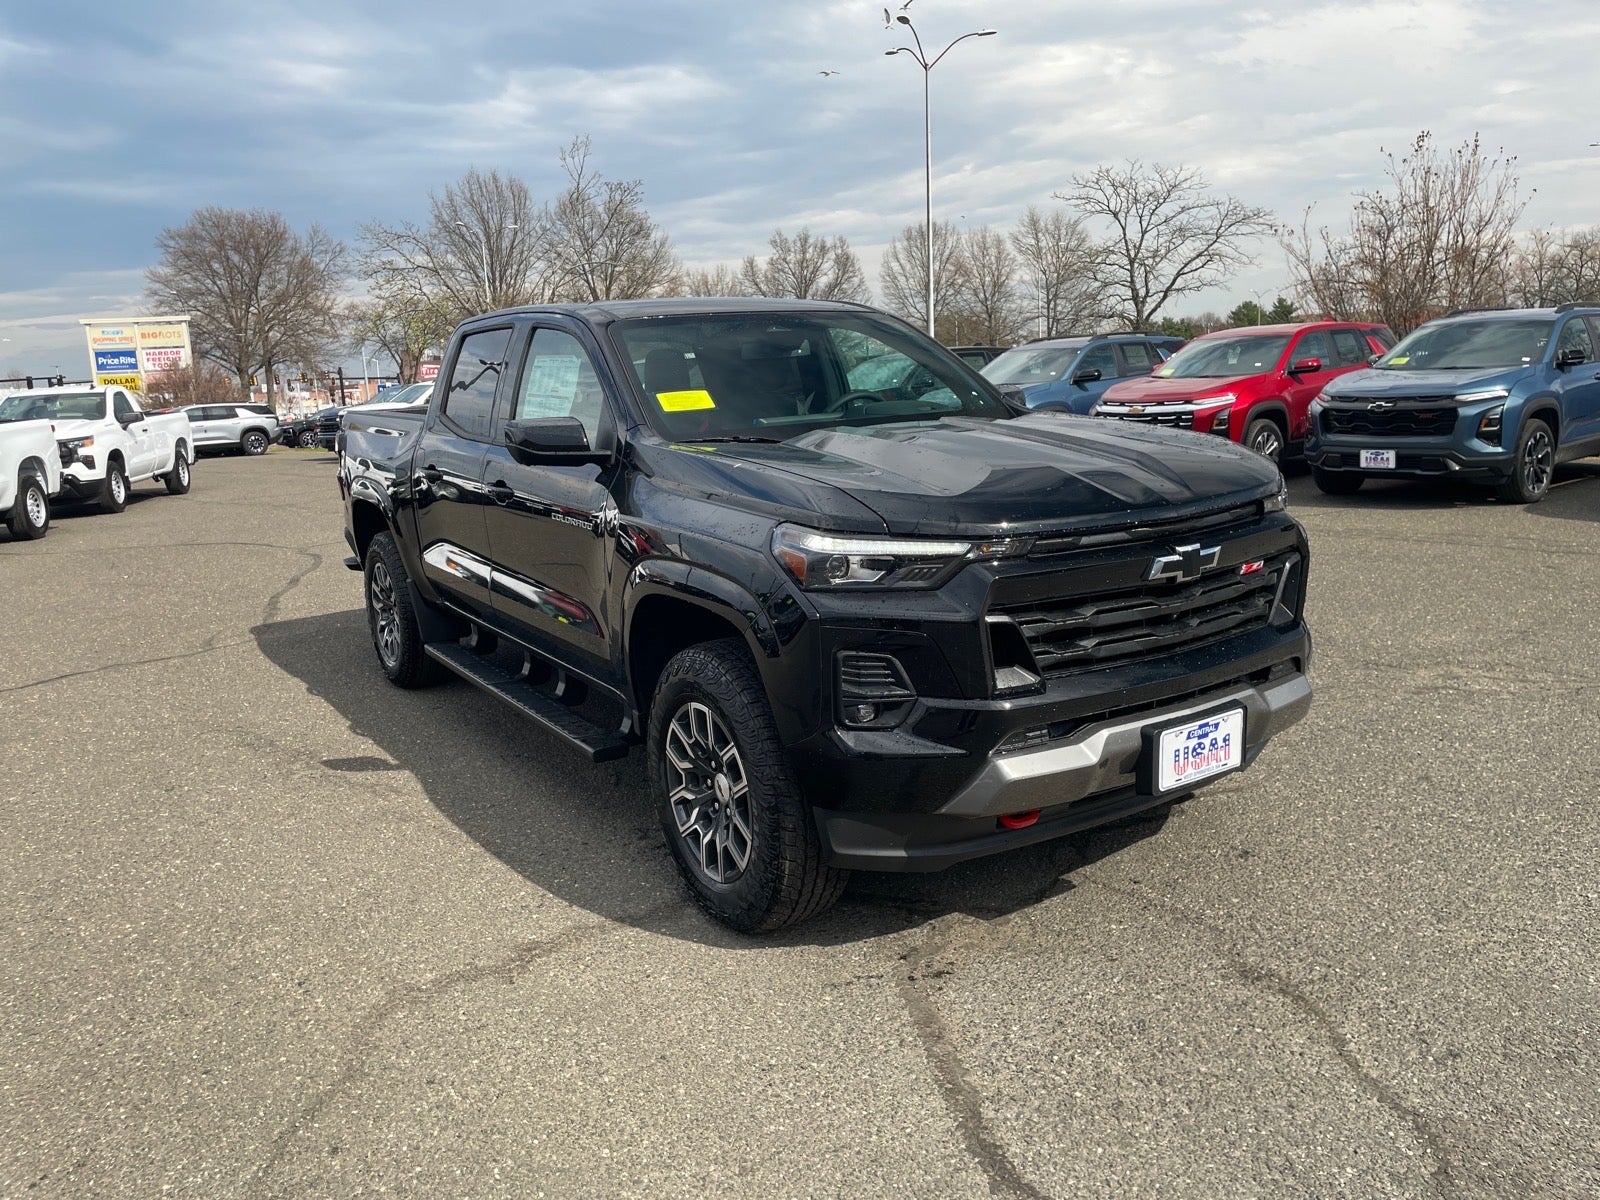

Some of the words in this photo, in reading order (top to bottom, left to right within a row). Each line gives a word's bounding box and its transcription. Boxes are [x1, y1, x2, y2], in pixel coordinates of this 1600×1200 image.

[98, 356, 119, 365] Price
[120, 356, 136, 364] Rite
[551, 512, 593, 530] COLORADO
[1190, 724, 1217, 738] CENTRAL
